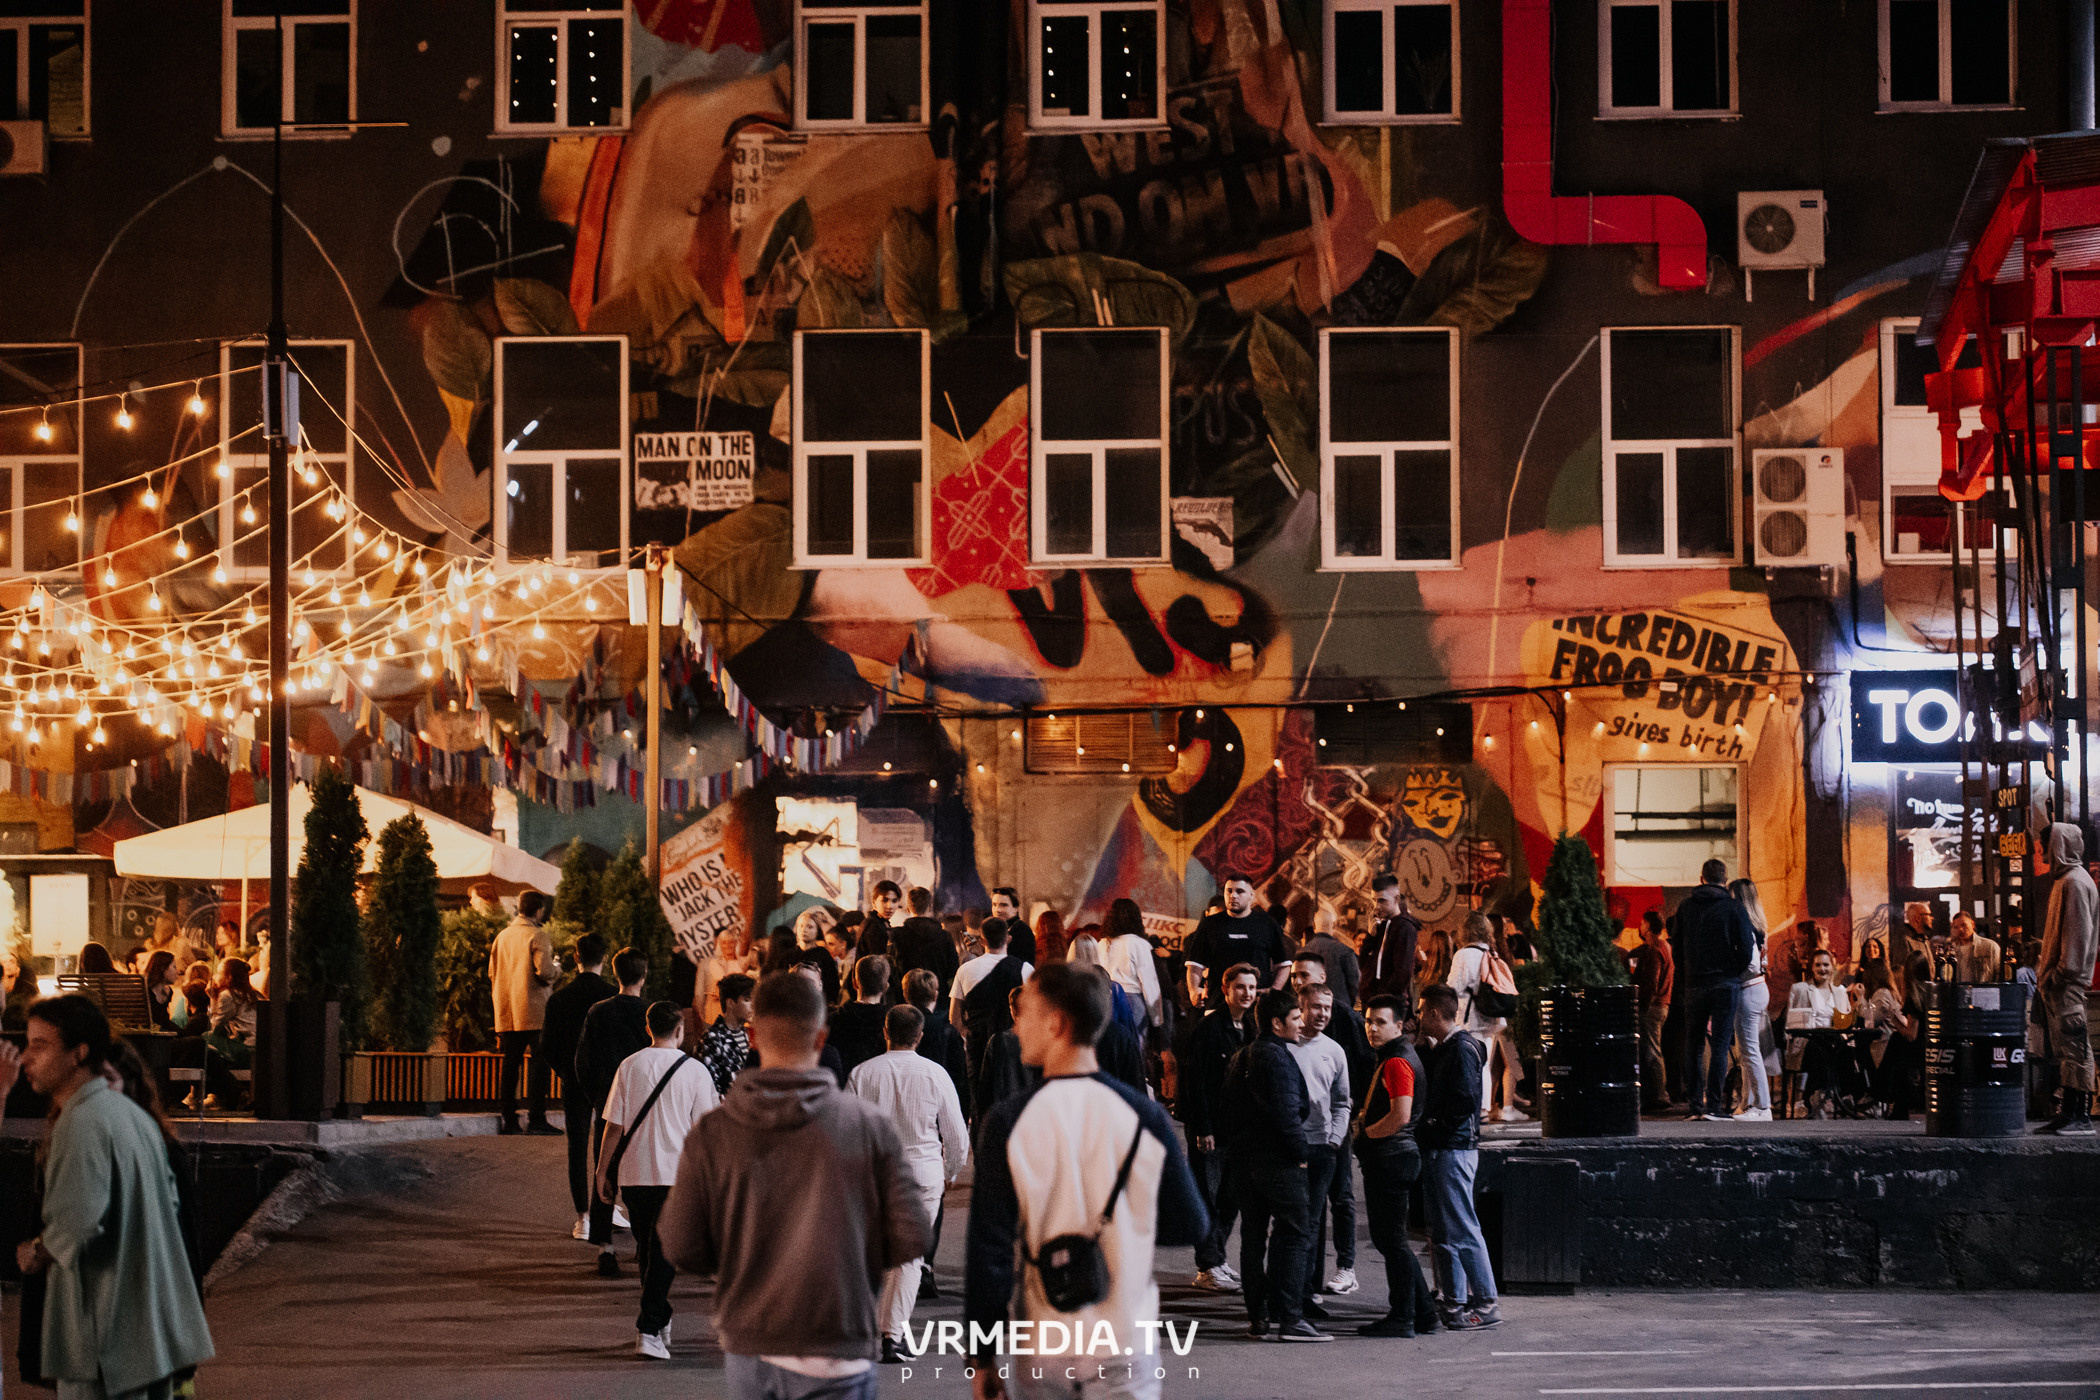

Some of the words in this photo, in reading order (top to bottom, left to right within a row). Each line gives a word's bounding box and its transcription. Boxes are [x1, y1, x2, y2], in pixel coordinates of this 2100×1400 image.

[637, 436, 680, 458] MAN
[718, 434, 751, 456] THE
[696, 459, 751, 480] MOON
[1606, 712, 1670, 744] gives
[1680, 724, 1744, 759] birth
[1998, 788, 2017, 807] SPOT
[660, 871, 702, 907] WHO
[701, 859, 722, 882] IS
